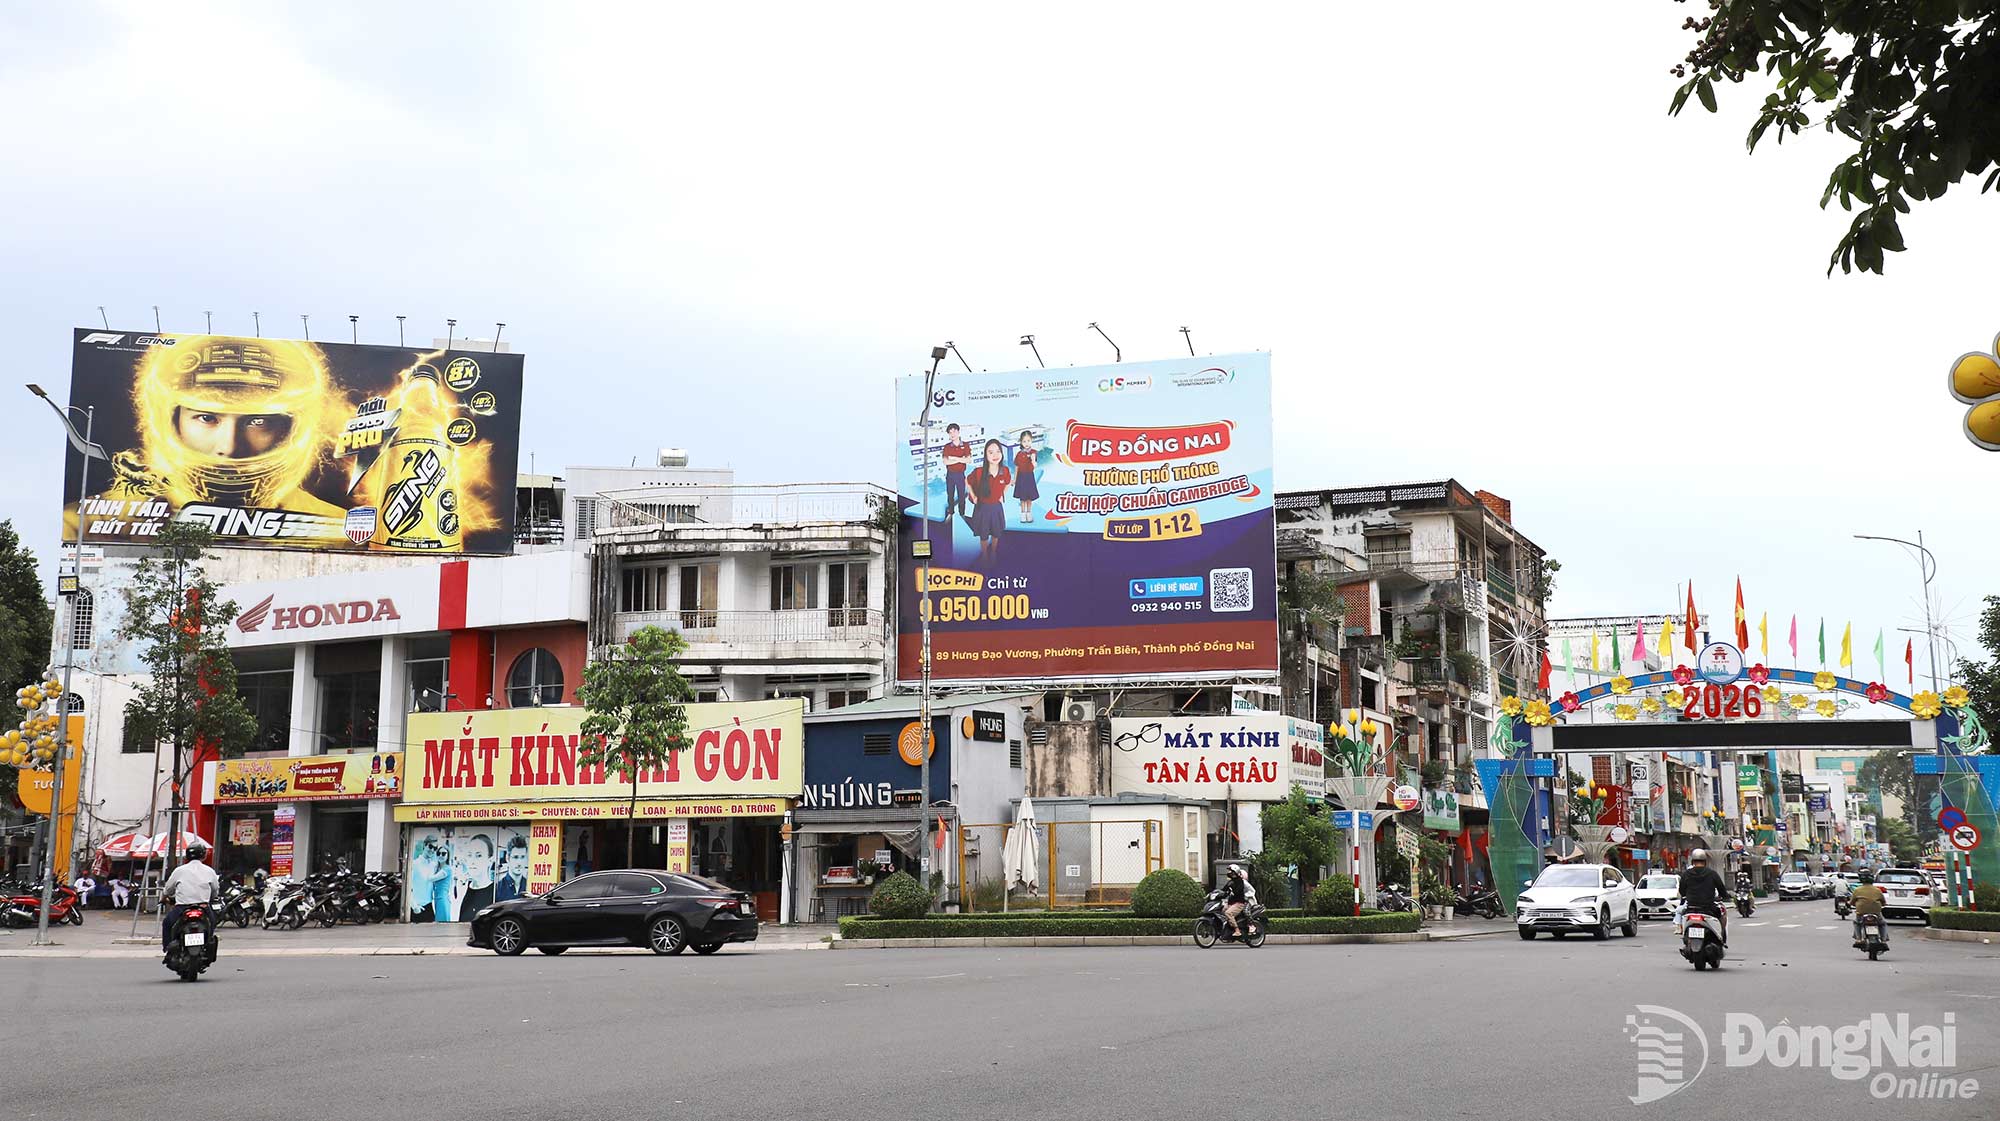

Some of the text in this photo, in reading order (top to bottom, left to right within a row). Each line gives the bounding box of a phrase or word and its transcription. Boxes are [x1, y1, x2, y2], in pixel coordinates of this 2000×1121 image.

[135, 336, 177, 346] STING
[448, 366, 476, 382] 8X
[357, 397, 387, 416] MỚI
[347, 417, 385, 432] GOLD
[336, 430, 385, 455] PRO
[1081, 432, 1221, 456] IPS ĐỒNG NAI
[1084, 467, 1138, 486] TRƯỜNG
[1174, 461, 1220, 480] THÔNG
[384, 450, 440, 532] STING
[1058, 492, 1088, 511] TÍCH
[1091, 494, 1118, 514] HỢP
[1170, 476, 1248, 504] CAMBRIDGE
[89, 519, 126, 535] BÚT
[1154, 513, 1193, 536] 1-12
[955, 575, 976, 587] PHÍ
[987, 575, 1010, 589] Chỉ
[1013, 577, 1028, 588] từ
[1168, 582, 1177, 593] HỆ
[1179, 582, 1198, 592] NGAY
[273, 598, 401, 631] HONDA
[919, 594, 1049, 622] 9.950.000 VNĐ
[1131, 601, 1202, 612] 0932 940 515
[936, 651, 949, 661] 89
[952, 650, 979, 661] Hưng
[982, 650, 1003, 661] Đạo
[1005, 649, 1042, 660] Vương,
[1044, 646, 1084, 658] Phường
[1114, 644, 1141, 655] Biên,
[1143, 642, 1177, 654] Thành
[1179, 641, 1201, 655] phố
[1236, 640, 1255, 651] Nai
[1683, 684, 1762, 718] 2026
[1164, 723, 1280, 748] MẮT KÍNH
[423, 715, 499, 789] MẮT
[510, 722, 606, 786] KÍNH
[694, 716, 782, 783] GÒN
[1143, 757, 1189, 783] TÂN
[1195, 756, 1211, 783] Á
[1215, 756, 1278, 783] CHÂU
[803, 777, 892, 807] NHÚNG
[453, 808, 471, 818] THEO
[643, 805, 666, 817] LOẠN
[675, 805, 690, 815] HAI
[731, 804, 743, 814] ĐA
[538, 843, 550, 856] ĐO
